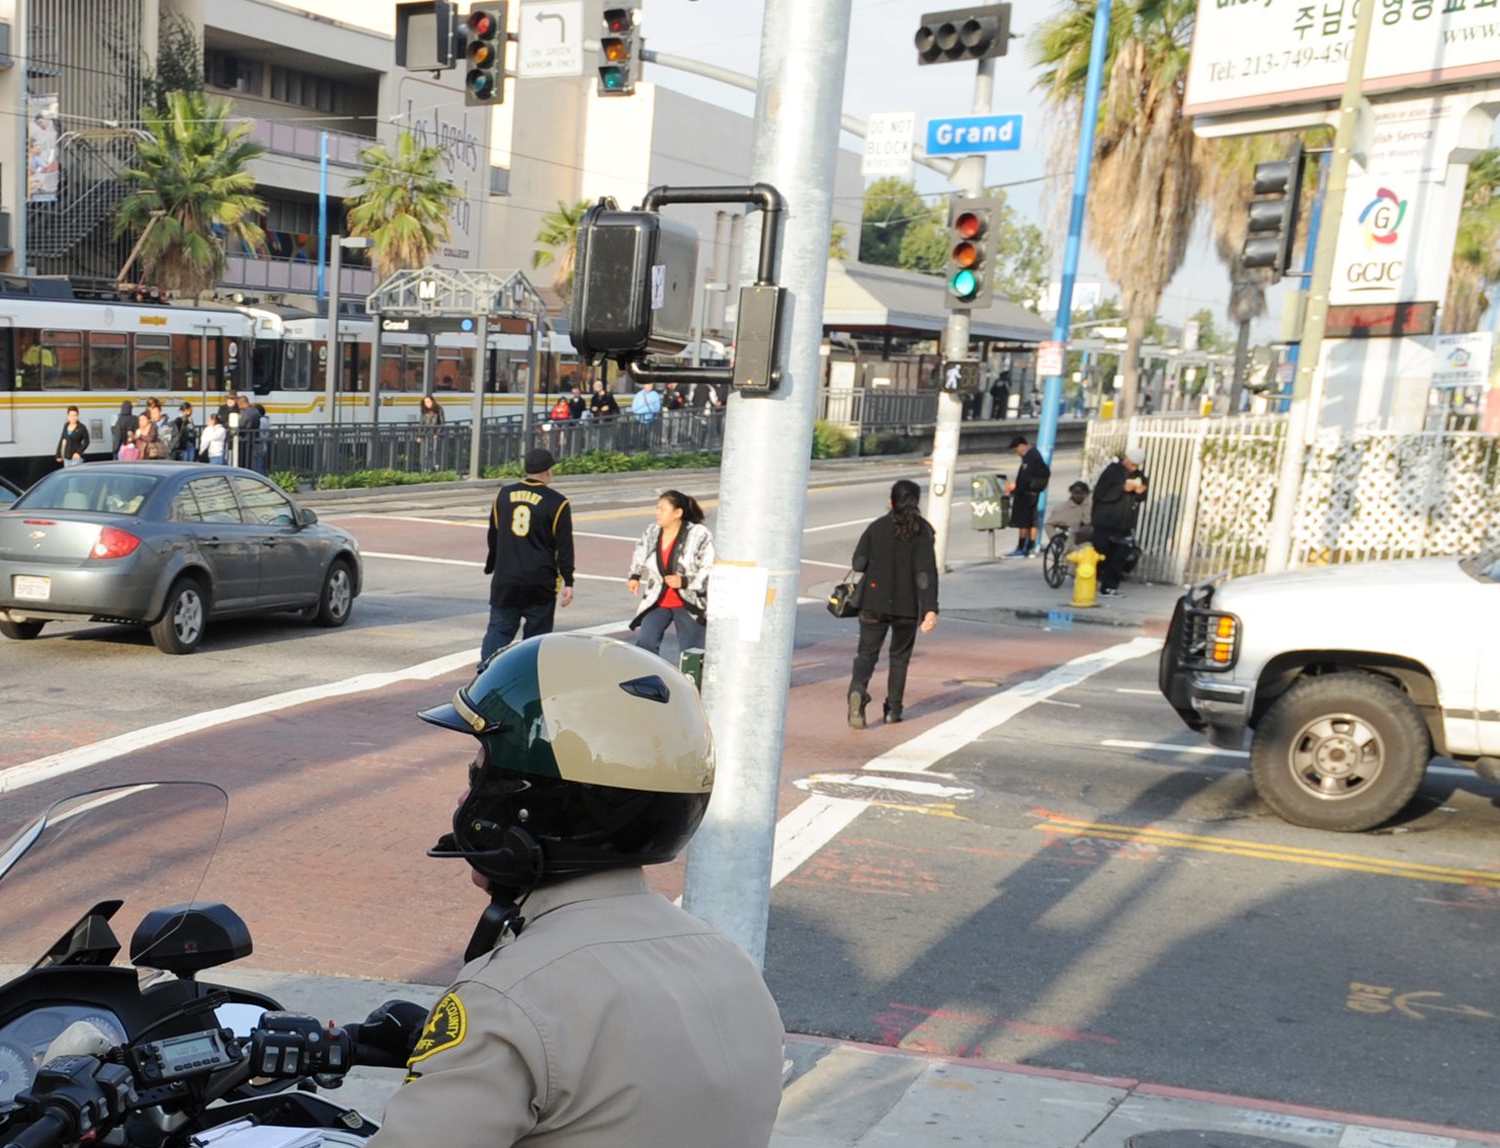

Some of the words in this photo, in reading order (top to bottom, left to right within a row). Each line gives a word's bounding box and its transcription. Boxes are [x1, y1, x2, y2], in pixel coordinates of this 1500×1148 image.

[1208, 60, 1235, 83] Tel:
[1241, 39, 1354, 77] 213-749-450
[936, 120, 1014, 146] Grand
[867, 140, 909, 155] BLOCK
[1374, 206, 1390, 229] G
[1347, 261, 1402, 283] GCJC
[419, 281, 436, 299] M
[511, 505, 531, 537] 8
[445, 1001, 460, 1039] COUNTY
